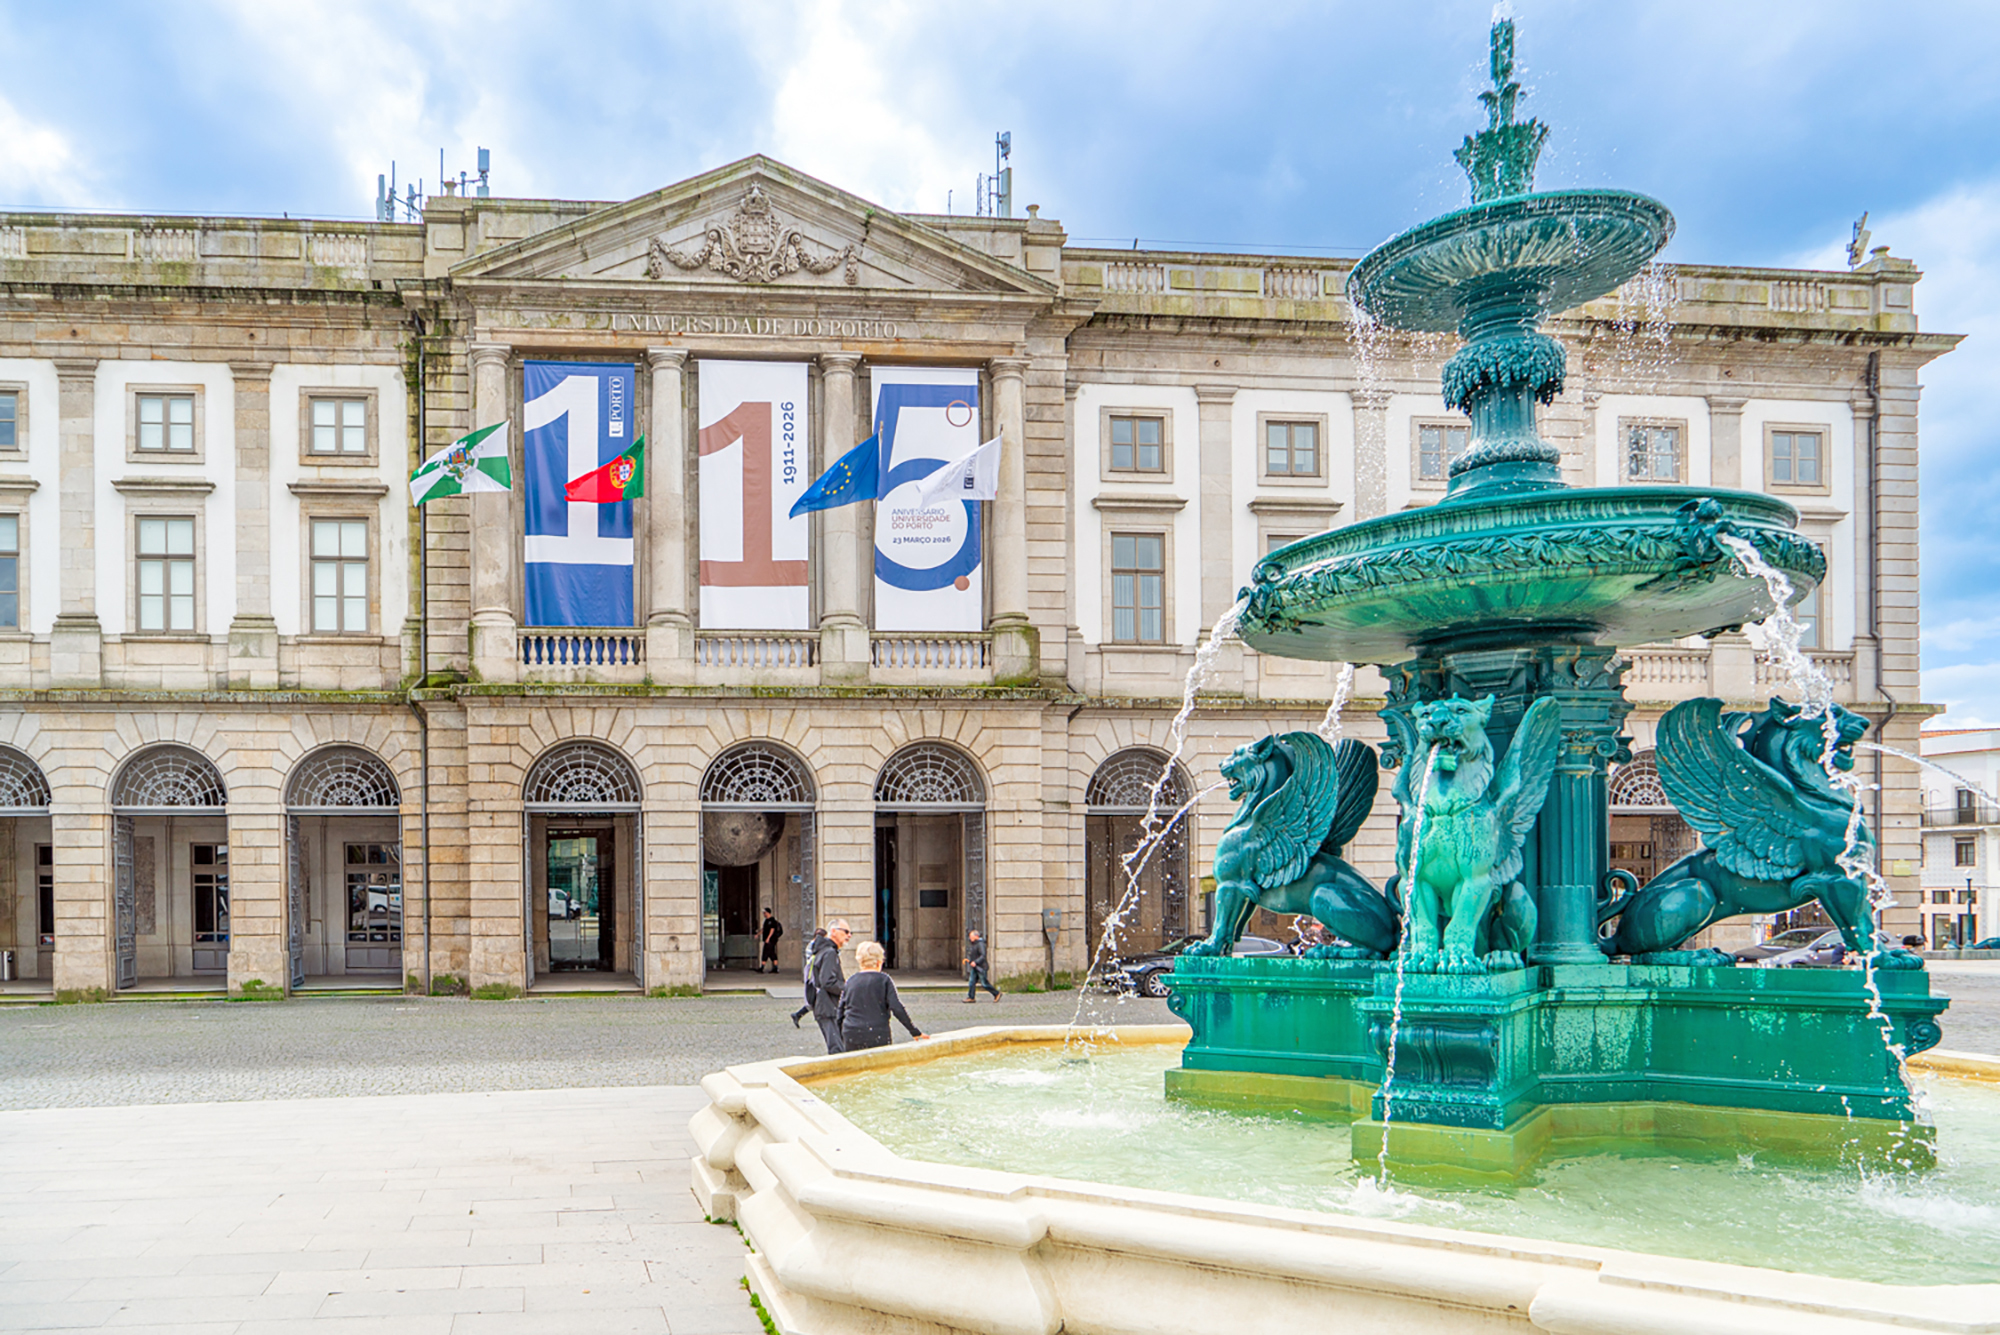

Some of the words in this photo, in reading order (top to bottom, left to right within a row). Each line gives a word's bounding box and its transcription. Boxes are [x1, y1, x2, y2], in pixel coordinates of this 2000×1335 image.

[611, 314, 784, 335] UNIVERSIDADE
[794, 319, 822, 336] DO
[830, 320, 898, 338] PORTO
[611, 378, 622, 420] PORTO
[781, 401, 797, 485] 1911-2026
[903, 536, 931, 544] MARÇO
